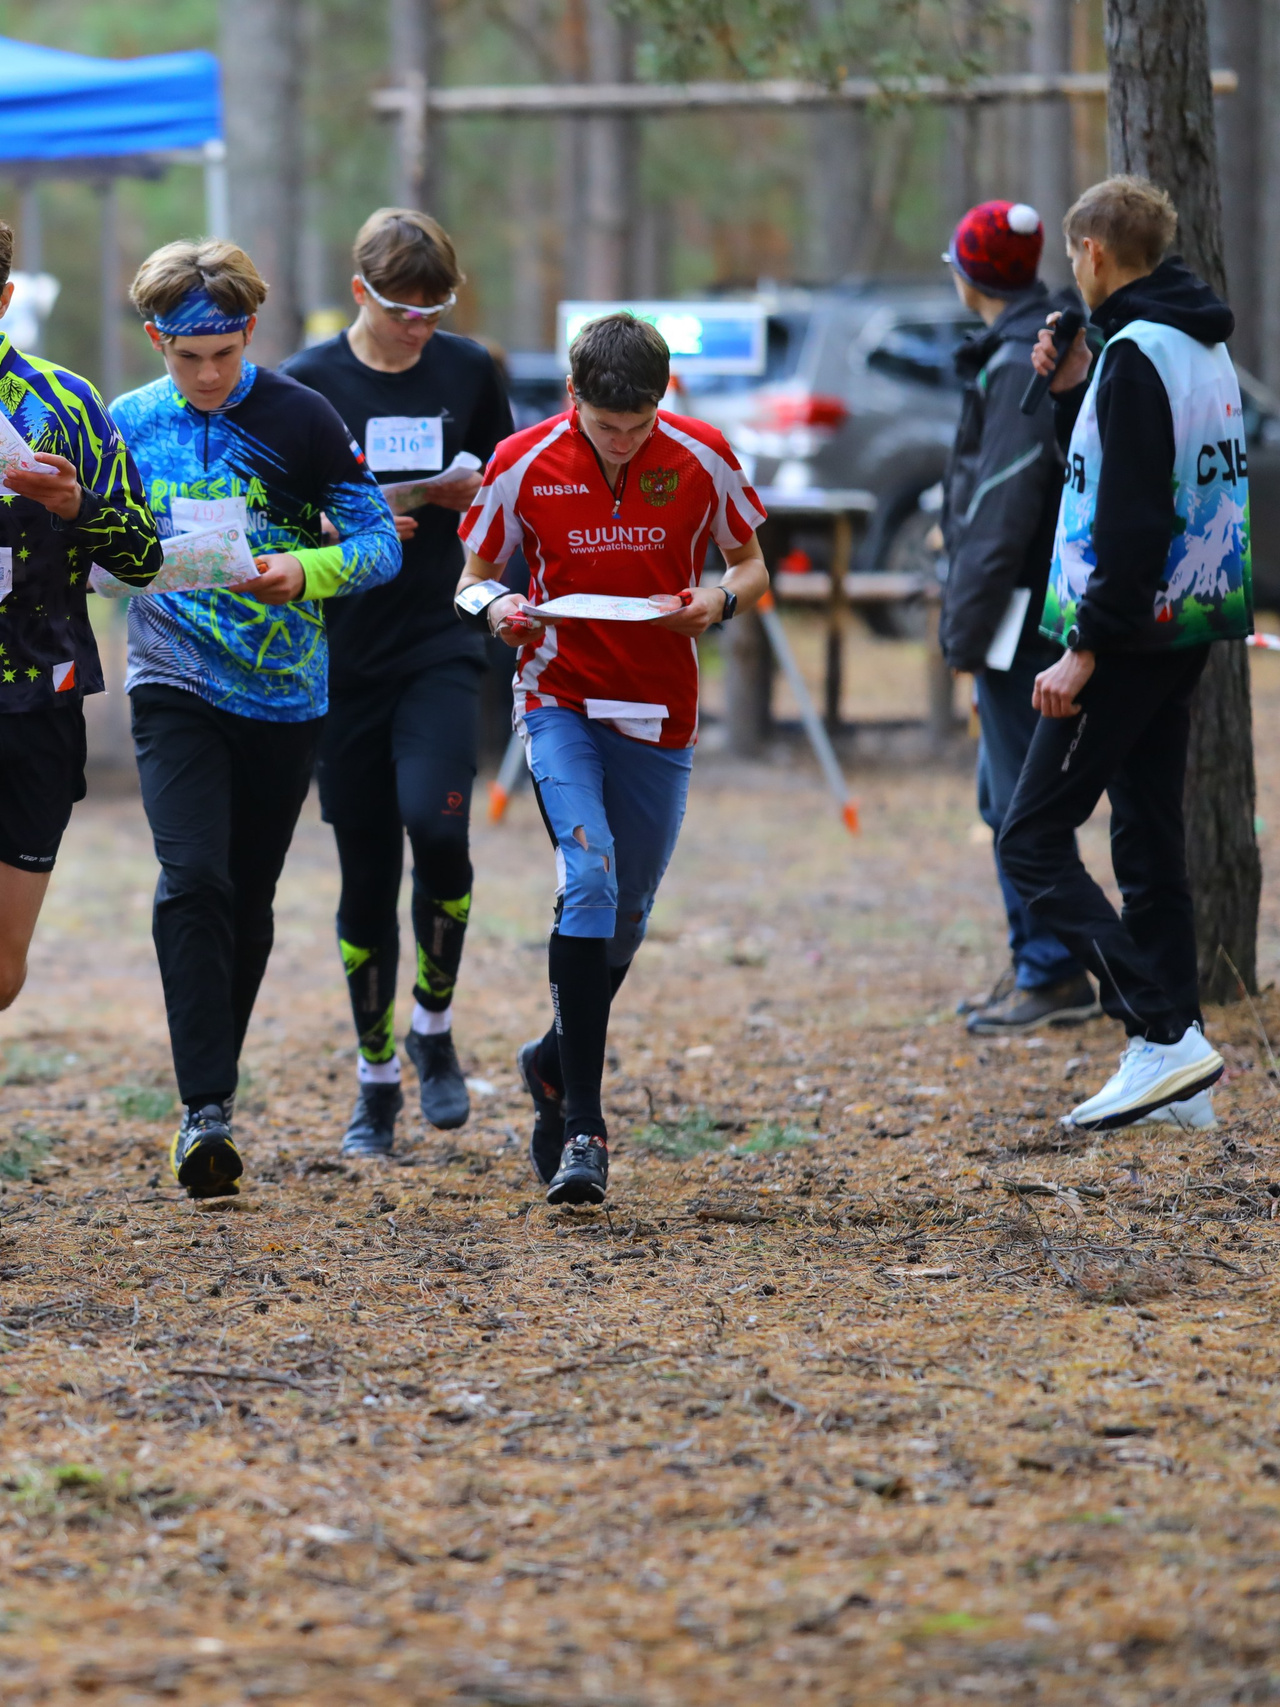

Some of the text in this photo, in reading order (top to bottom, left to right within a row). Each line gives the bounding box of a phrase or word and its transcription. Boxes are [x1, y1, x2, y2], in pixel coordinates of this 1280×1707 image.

[389, 436, 419, 453] 216
[150, 476, 268, 513] RUSSIA
[532, 484, 590, 497] RUSSIA
[192, 503, 225, 522] 202
[568, 526, 666, 546] SUUNTO
[570, 541, 665, 554] www.watchsport.ru
